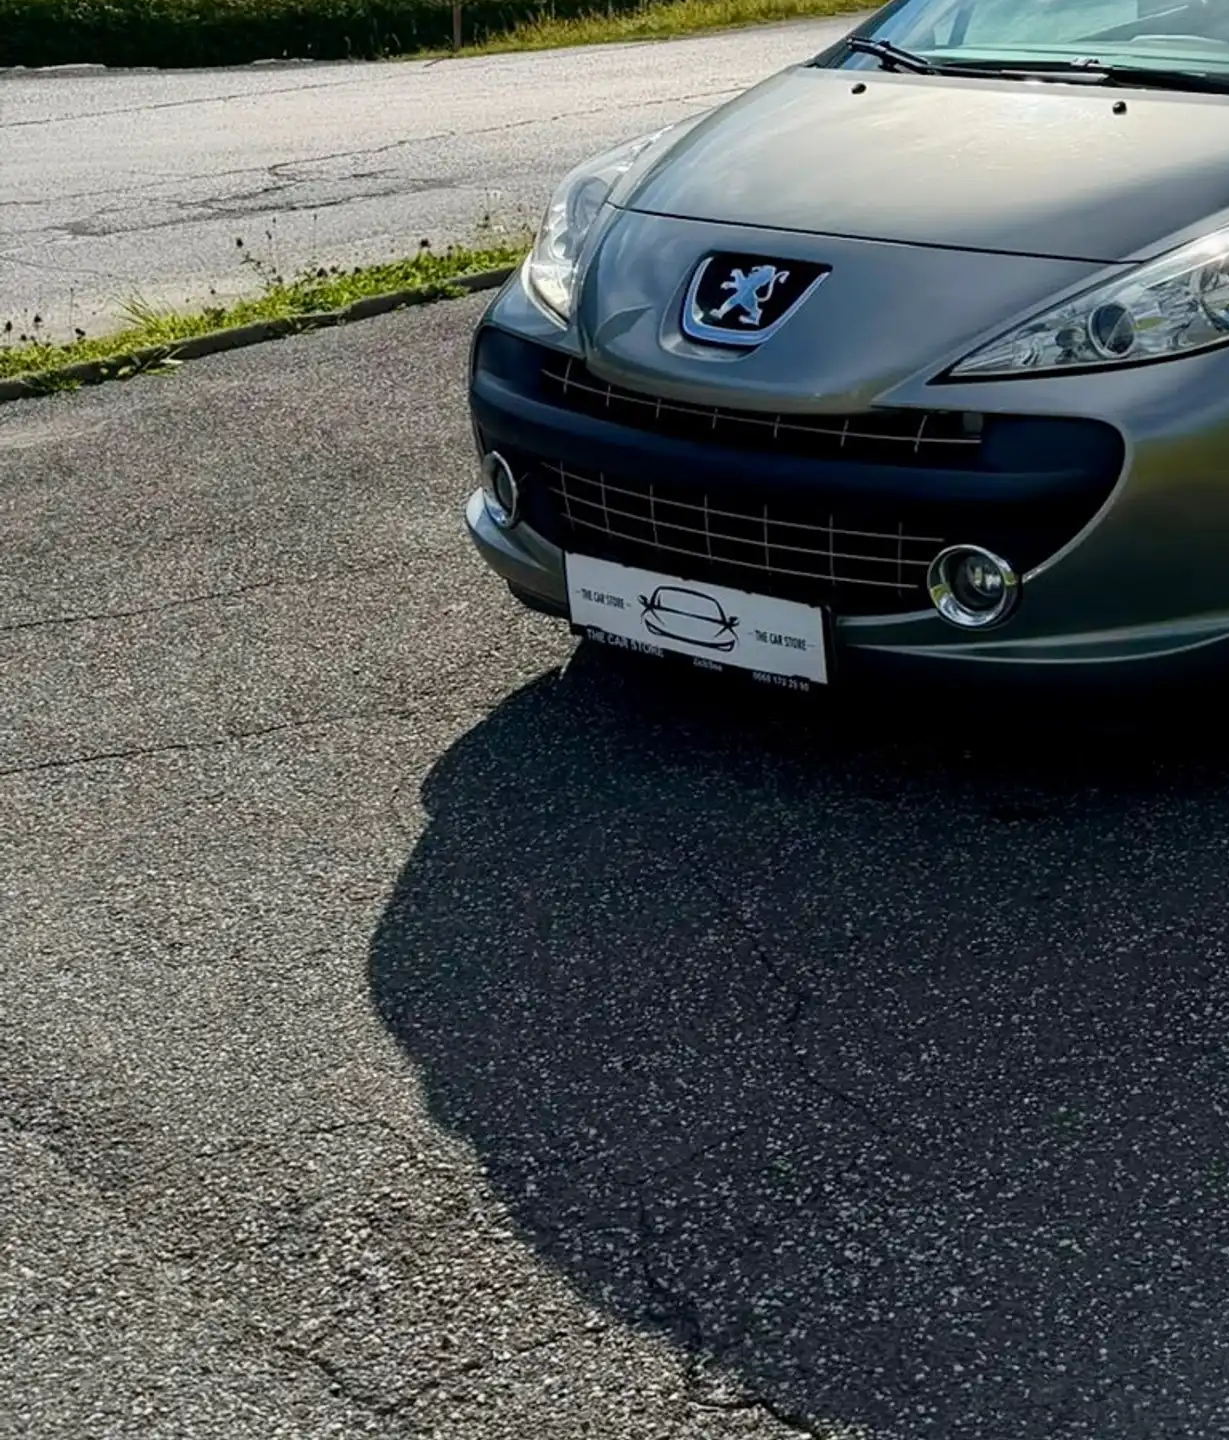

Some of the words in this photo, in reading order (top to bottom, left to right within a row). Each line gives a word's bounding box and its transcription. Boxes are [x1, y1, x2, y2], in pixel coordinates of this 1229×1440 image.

[581, 587, 593, 601] THE
[593, 591, 605, 604] CAR
[606, 594, 625, 609] STORE
[585, 627, 606, 644] THE
[607, 634, 630, 650] CAR
[631, 639, 665, 658] STORE
[755, 629, 768, 644] THE
[769, 632, 783, 646] CAR
[784, 635, 807, 651] STORE
